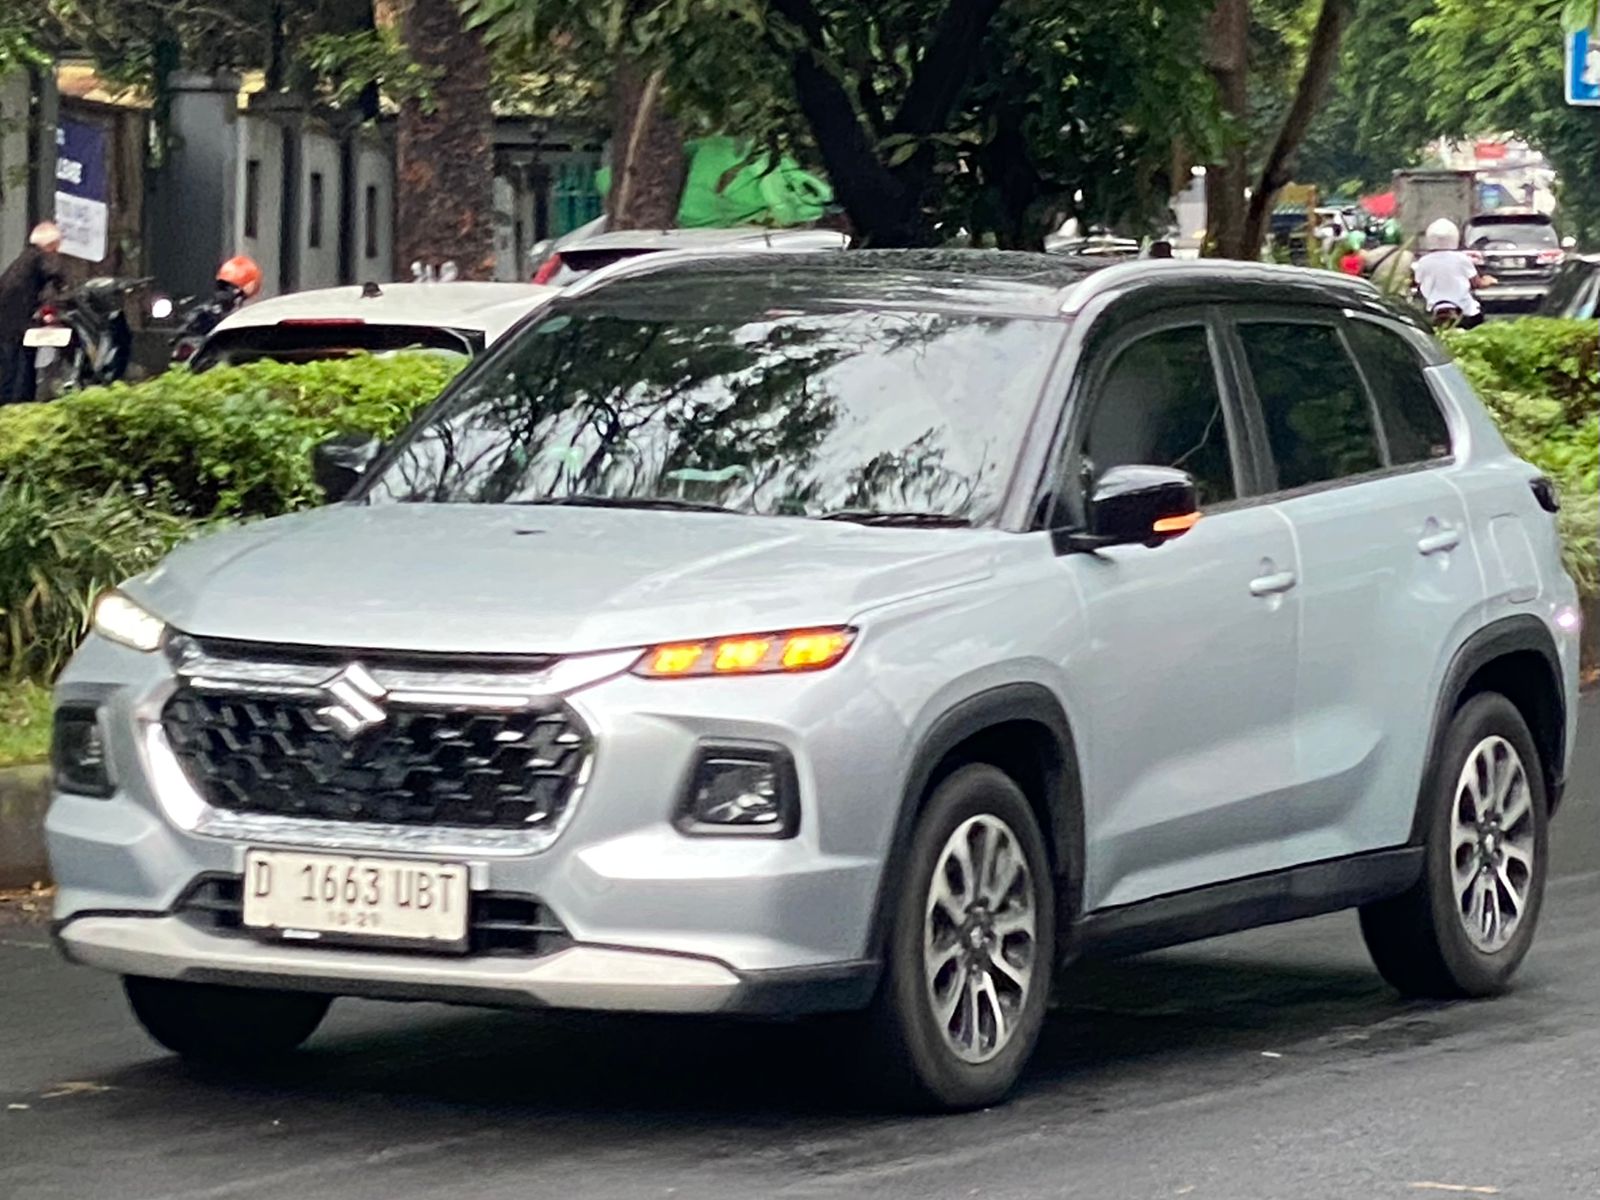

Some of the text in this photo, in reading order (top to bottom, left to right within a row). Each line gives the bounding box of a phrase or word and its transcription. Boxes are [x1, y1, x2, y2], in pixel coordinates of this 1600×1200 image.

[255, 861, 456, 913] D 1663 UBT
